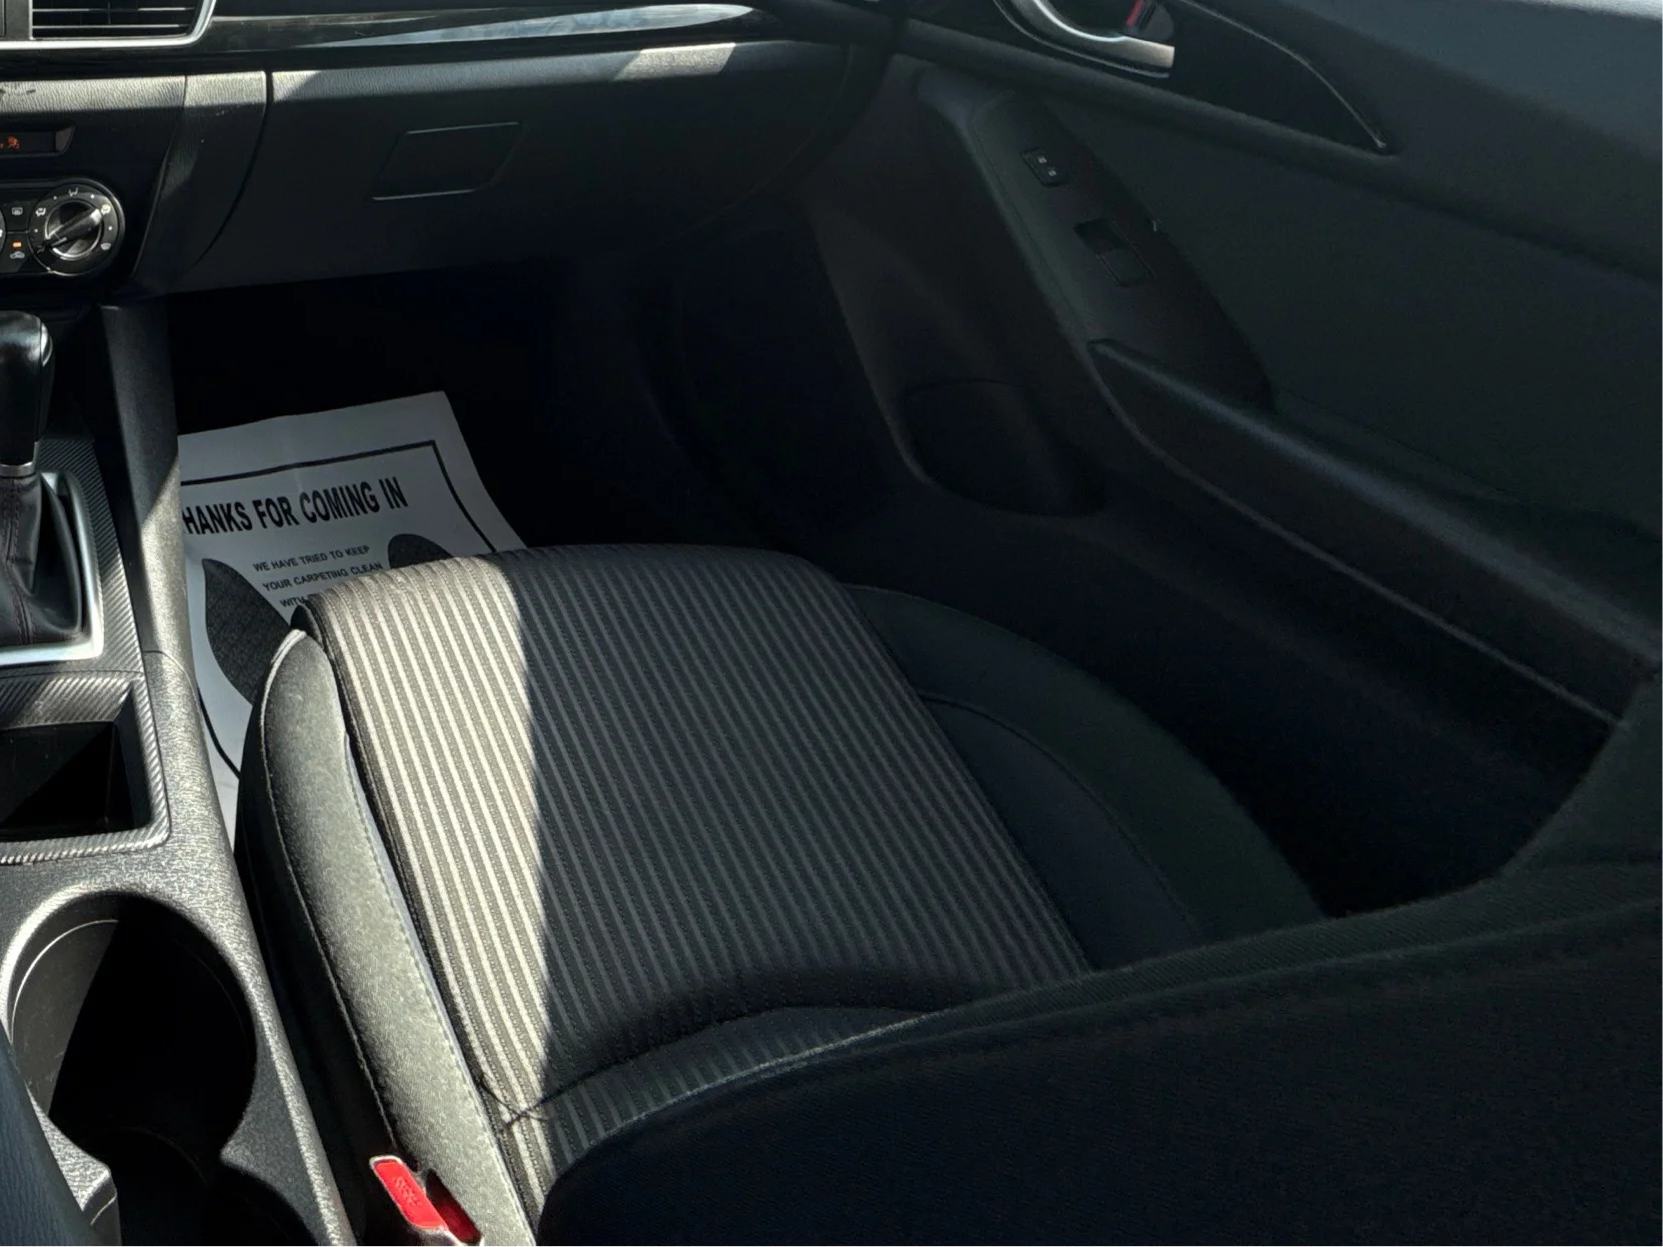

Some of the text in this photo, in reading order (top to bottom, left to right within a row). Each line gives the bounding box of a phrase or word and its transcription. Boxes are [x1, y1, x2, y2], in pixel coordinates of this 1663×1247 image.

[181, 476, 409, 535] HANKS FOR COMING IN
[253, 544, 370, 573] WE HAVE TRIED TO KEEP
[261, 562, 384, 592] YOUR CARPETING CLEAN
